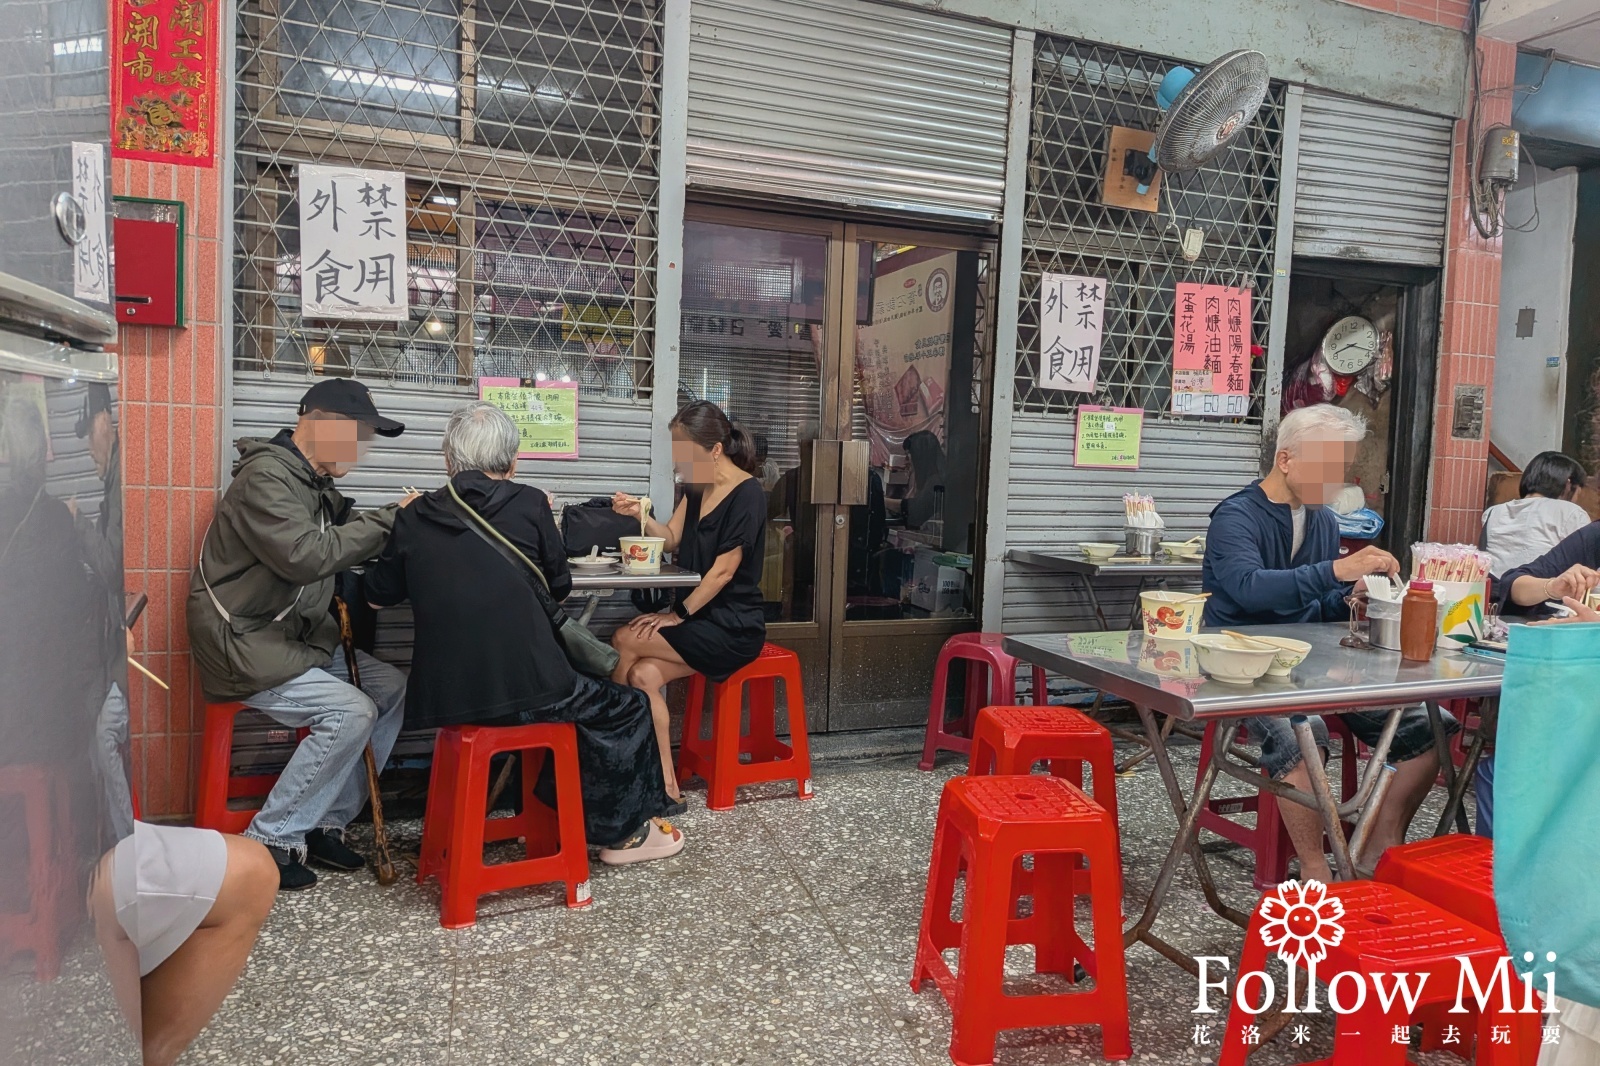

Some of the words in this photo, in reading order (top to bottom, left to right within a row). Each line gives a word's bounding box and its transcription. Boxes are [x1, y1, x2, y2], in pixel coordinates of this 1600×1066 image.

[305, 181, 360, 305] 外食
[353, 181, 398, 305] 禁用
[1043, 281, 1074, 384] 外食
[1070, 282, 1102, 382] 禁用
[1179, 292, 1197, 355] 蛋花湯
[1341, 324, 1347, 332] 11
[1350, 321, 1358, 330] 12
[1366, 330, 1373, 338] 2
[1175, 394, 1193, 412] 40
[1203, 394, 1220, 413] 60
[1226, 395, 1243, 414] 60
